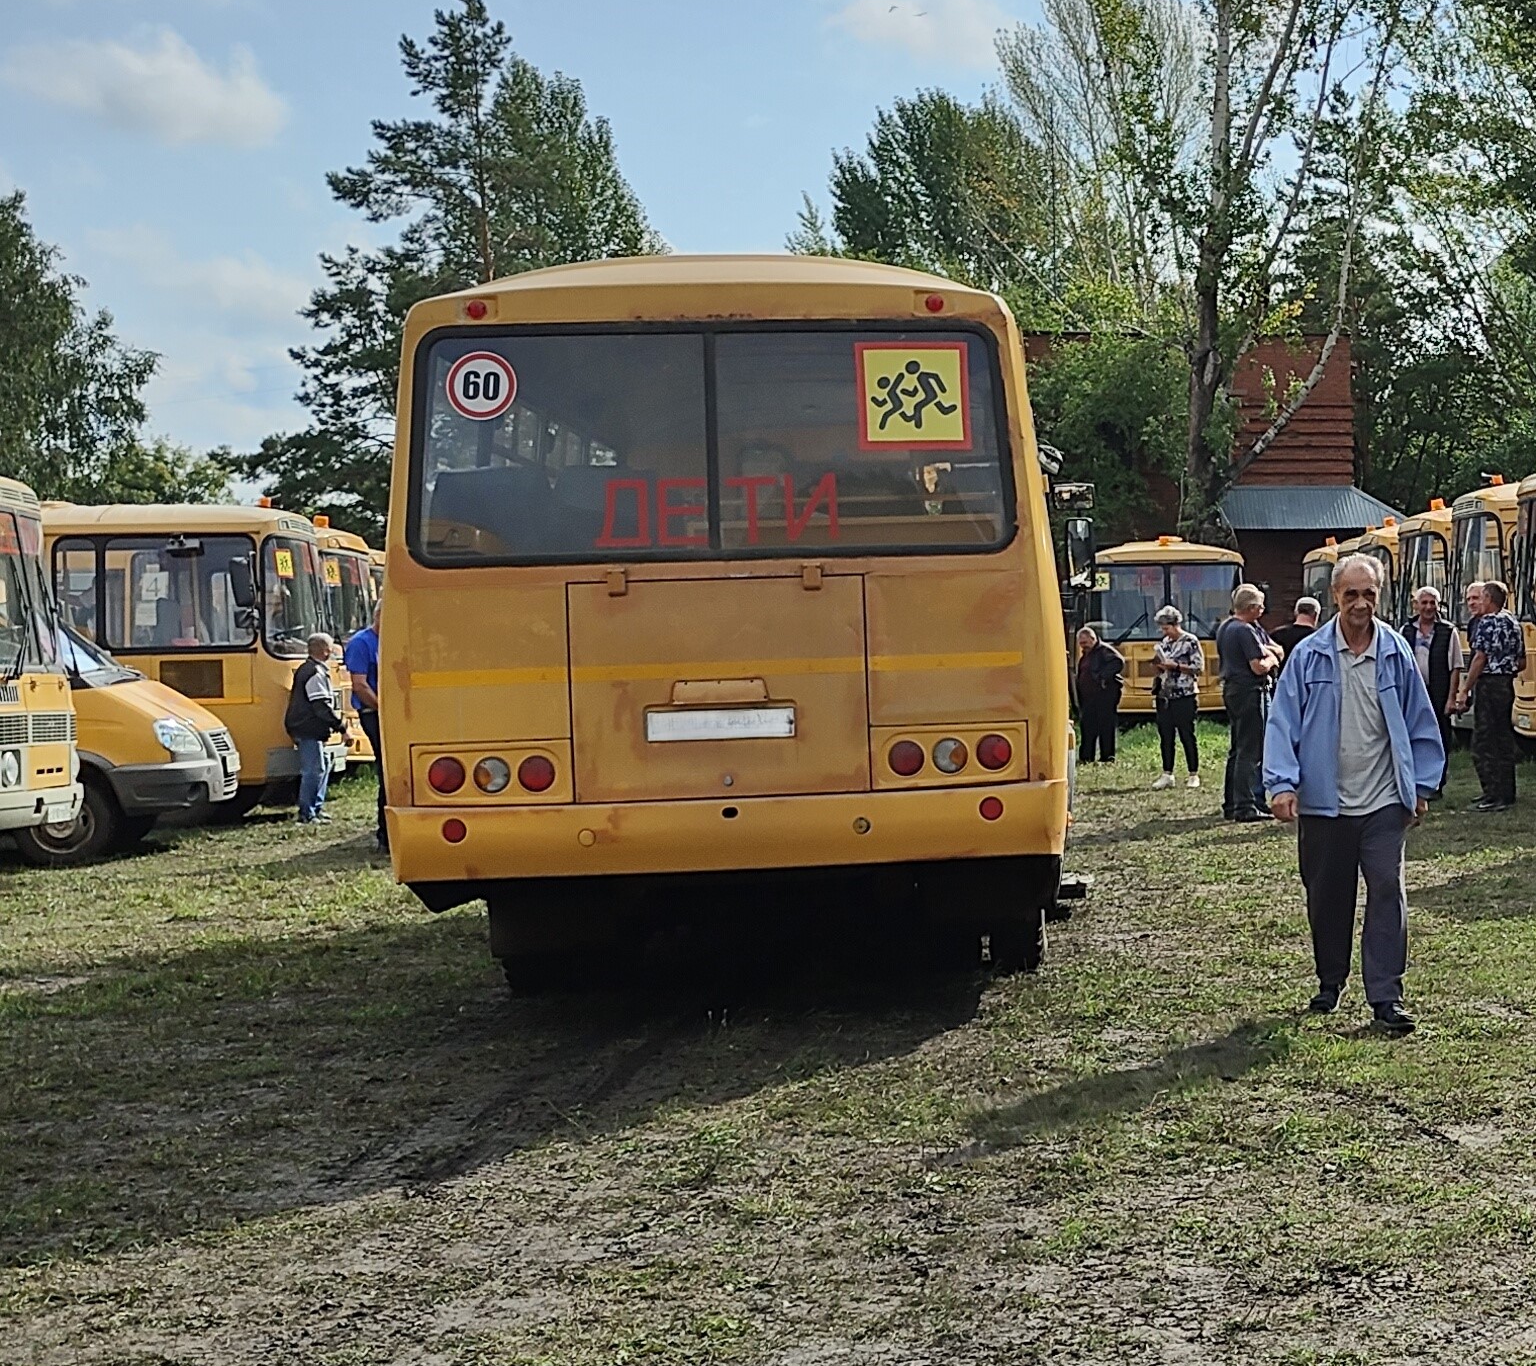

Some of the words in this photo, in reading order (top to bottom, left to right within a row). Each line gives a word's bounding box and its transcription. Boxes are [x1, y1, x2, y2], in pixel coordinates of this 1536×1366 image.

[462, 370, 501, 401] 60
[593, 471, 839, 548] ДЕТИ
[145, 577, 162, 598] 4
